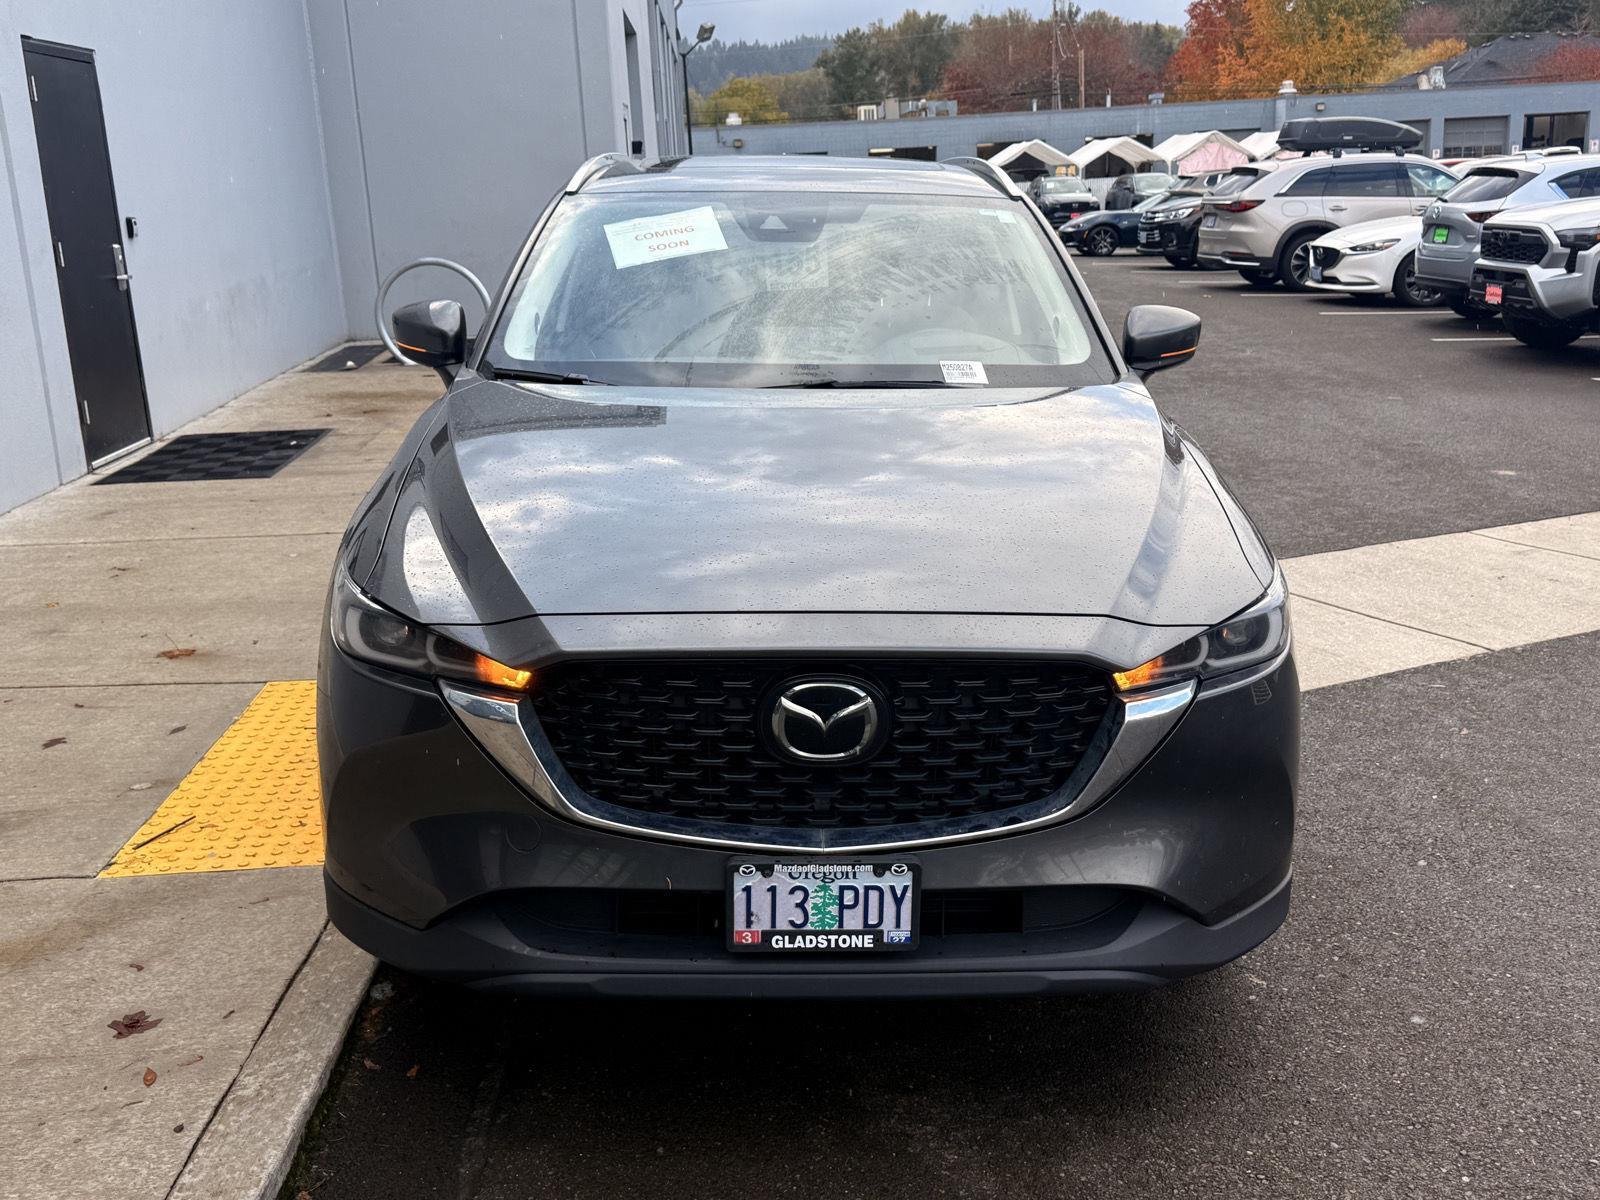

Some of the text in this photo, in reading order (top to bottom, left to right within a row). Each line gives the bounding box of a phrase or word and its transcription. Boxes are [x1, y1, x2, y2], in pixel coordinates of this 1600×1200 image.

[634, 225, 696, 241] COMING
[648, 239, 690, 252] SOON
[774, 864, 873, 873] MazdaofGladstone.com
[742, 884, 910, 929] 113 PDY
[742, 932, 752, 943] 3
[771, 935, 874, 948] GLADSTONE
